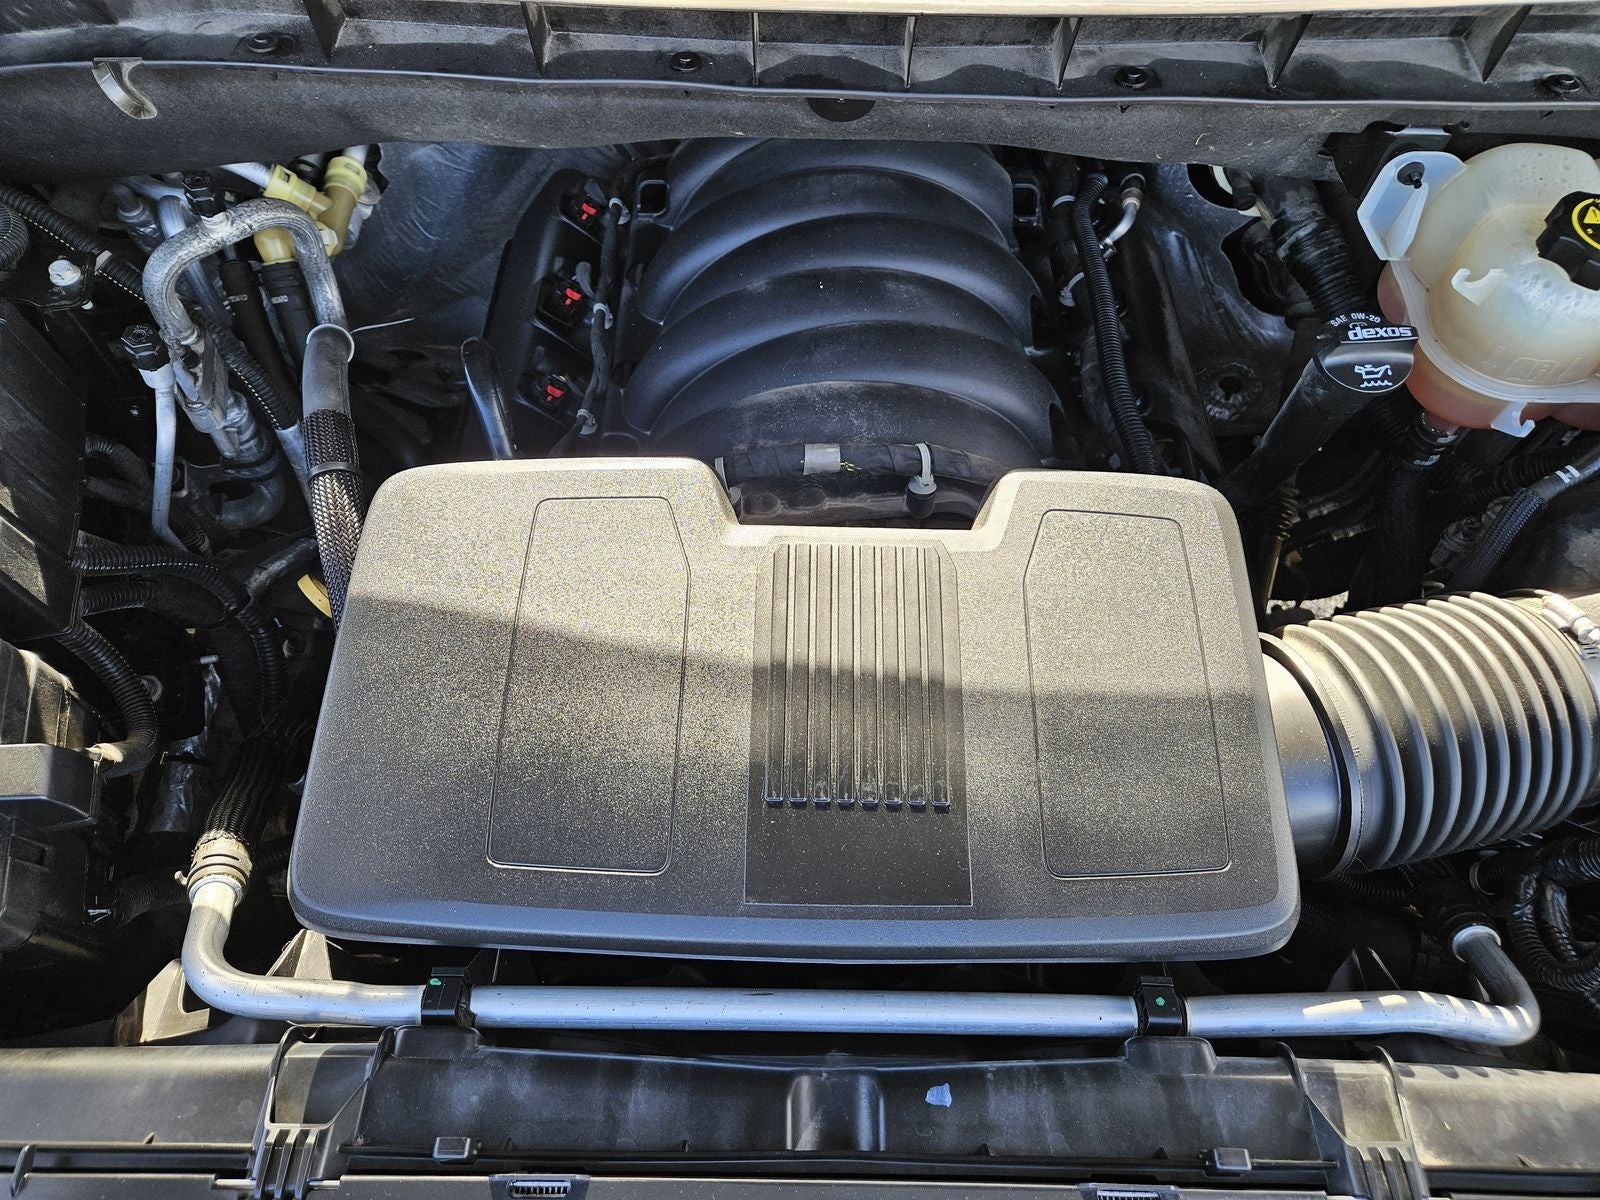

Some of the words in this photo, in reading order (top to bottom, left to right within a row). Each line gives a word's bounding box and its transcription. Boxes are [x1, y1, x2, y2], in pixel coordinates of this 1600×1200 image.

[1330, 314, 1348, 327] SAE
[1350, 312, 1381, 324] 0W-20
[1347, 325, 1412, 341] dexos
